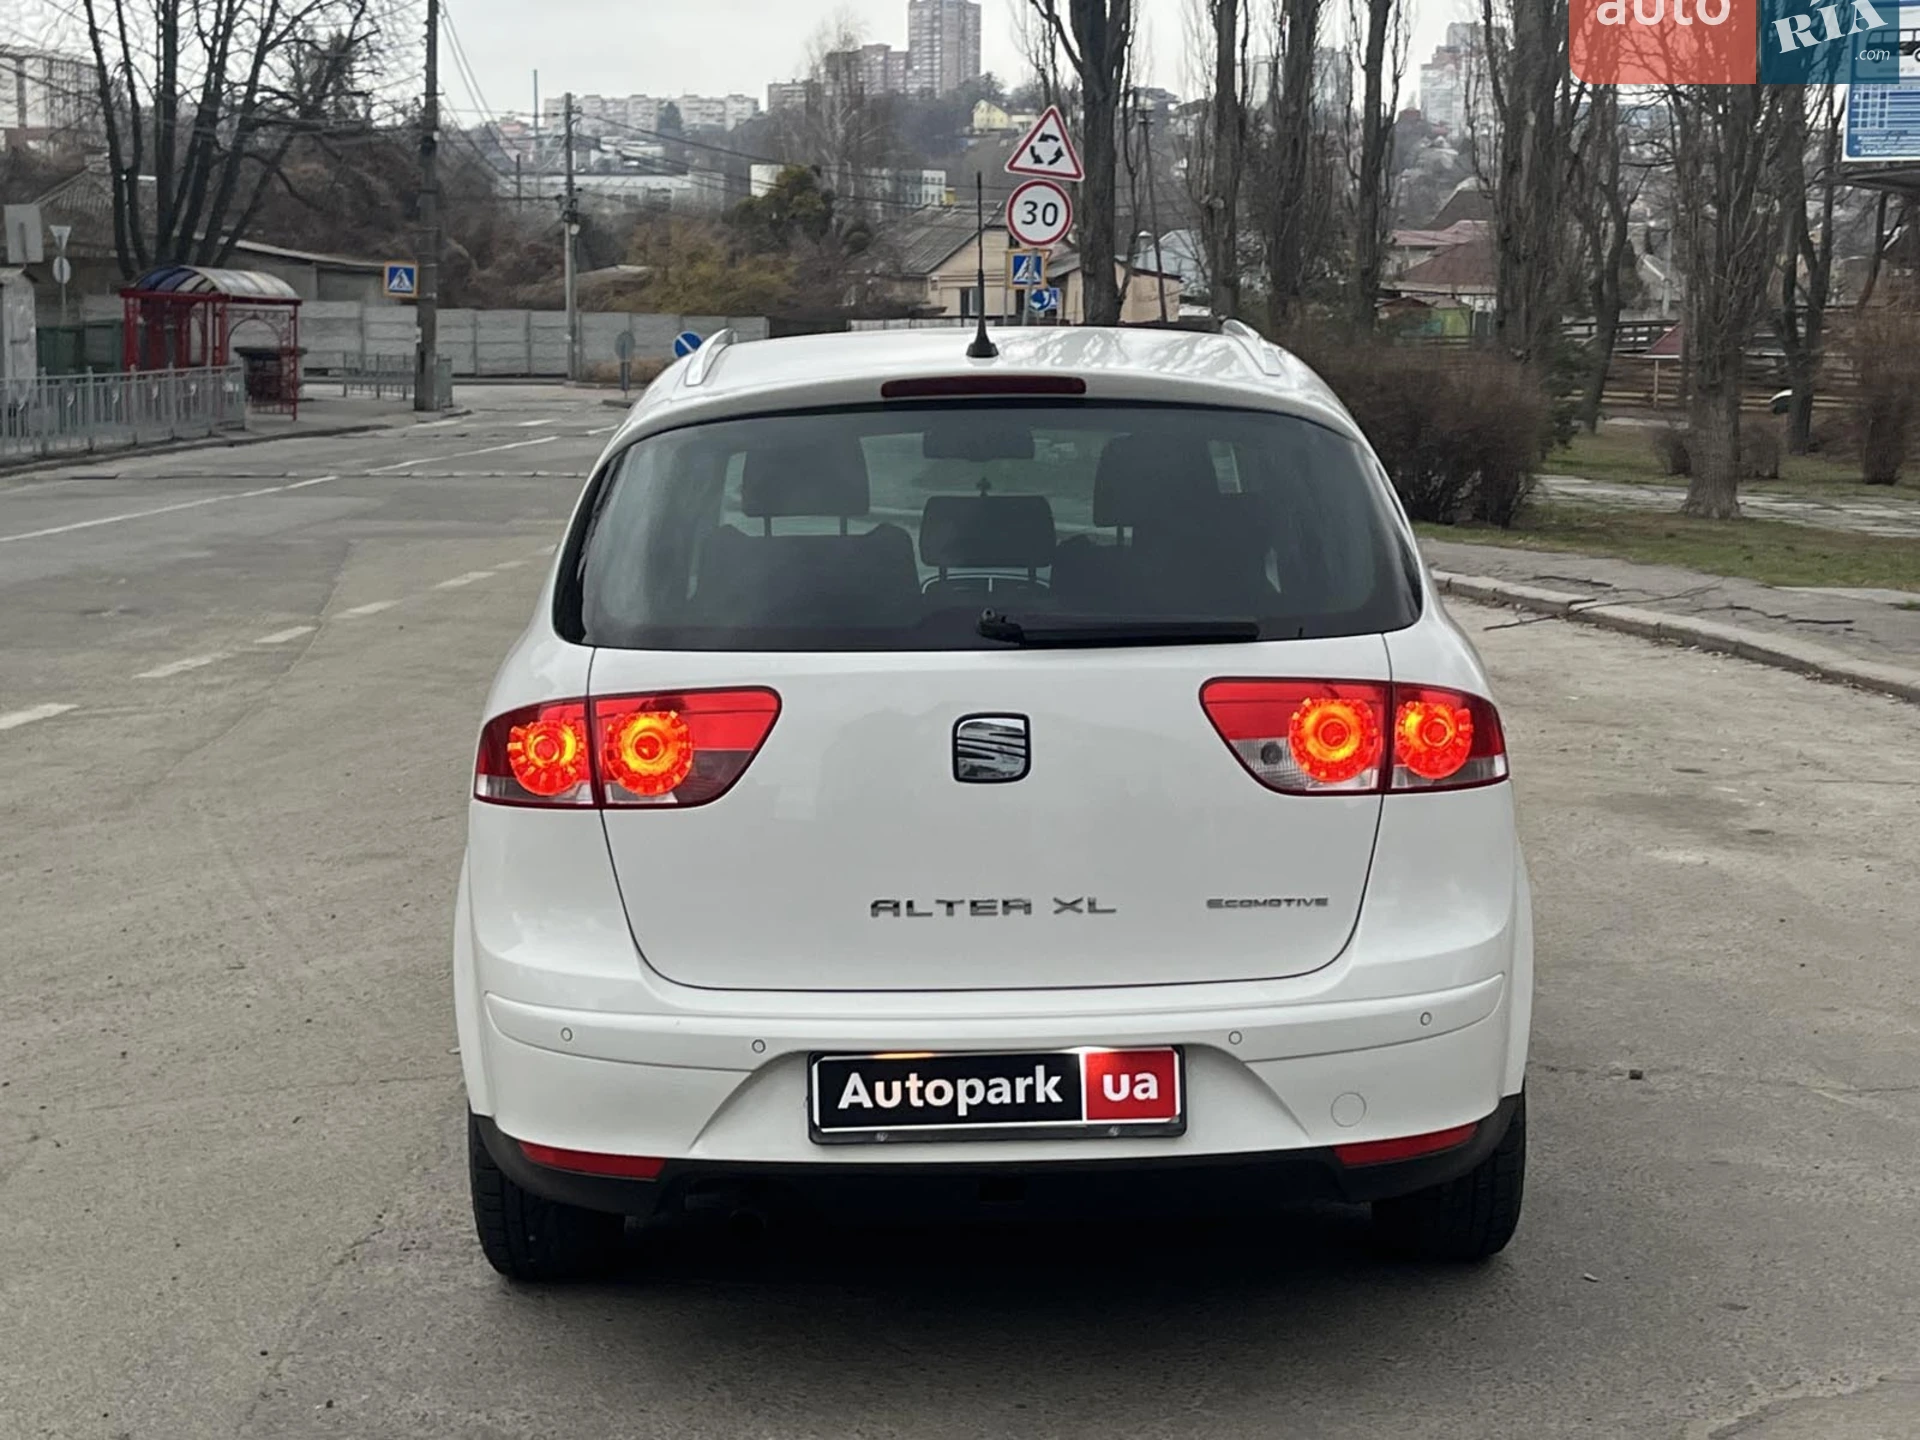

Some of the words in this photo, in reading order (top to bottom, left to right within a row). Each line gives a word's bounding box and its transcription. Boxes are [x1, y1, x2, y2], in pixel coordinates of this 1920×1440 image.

[1021, 201, 1059, 227] 30
[870, 899, 1032, 917] ALTEA
[1053, 897, 1117, 914] XL
[838, 1065, 1063, 1116] Autopark
[1102, 1072, 1159, 1102] ua
